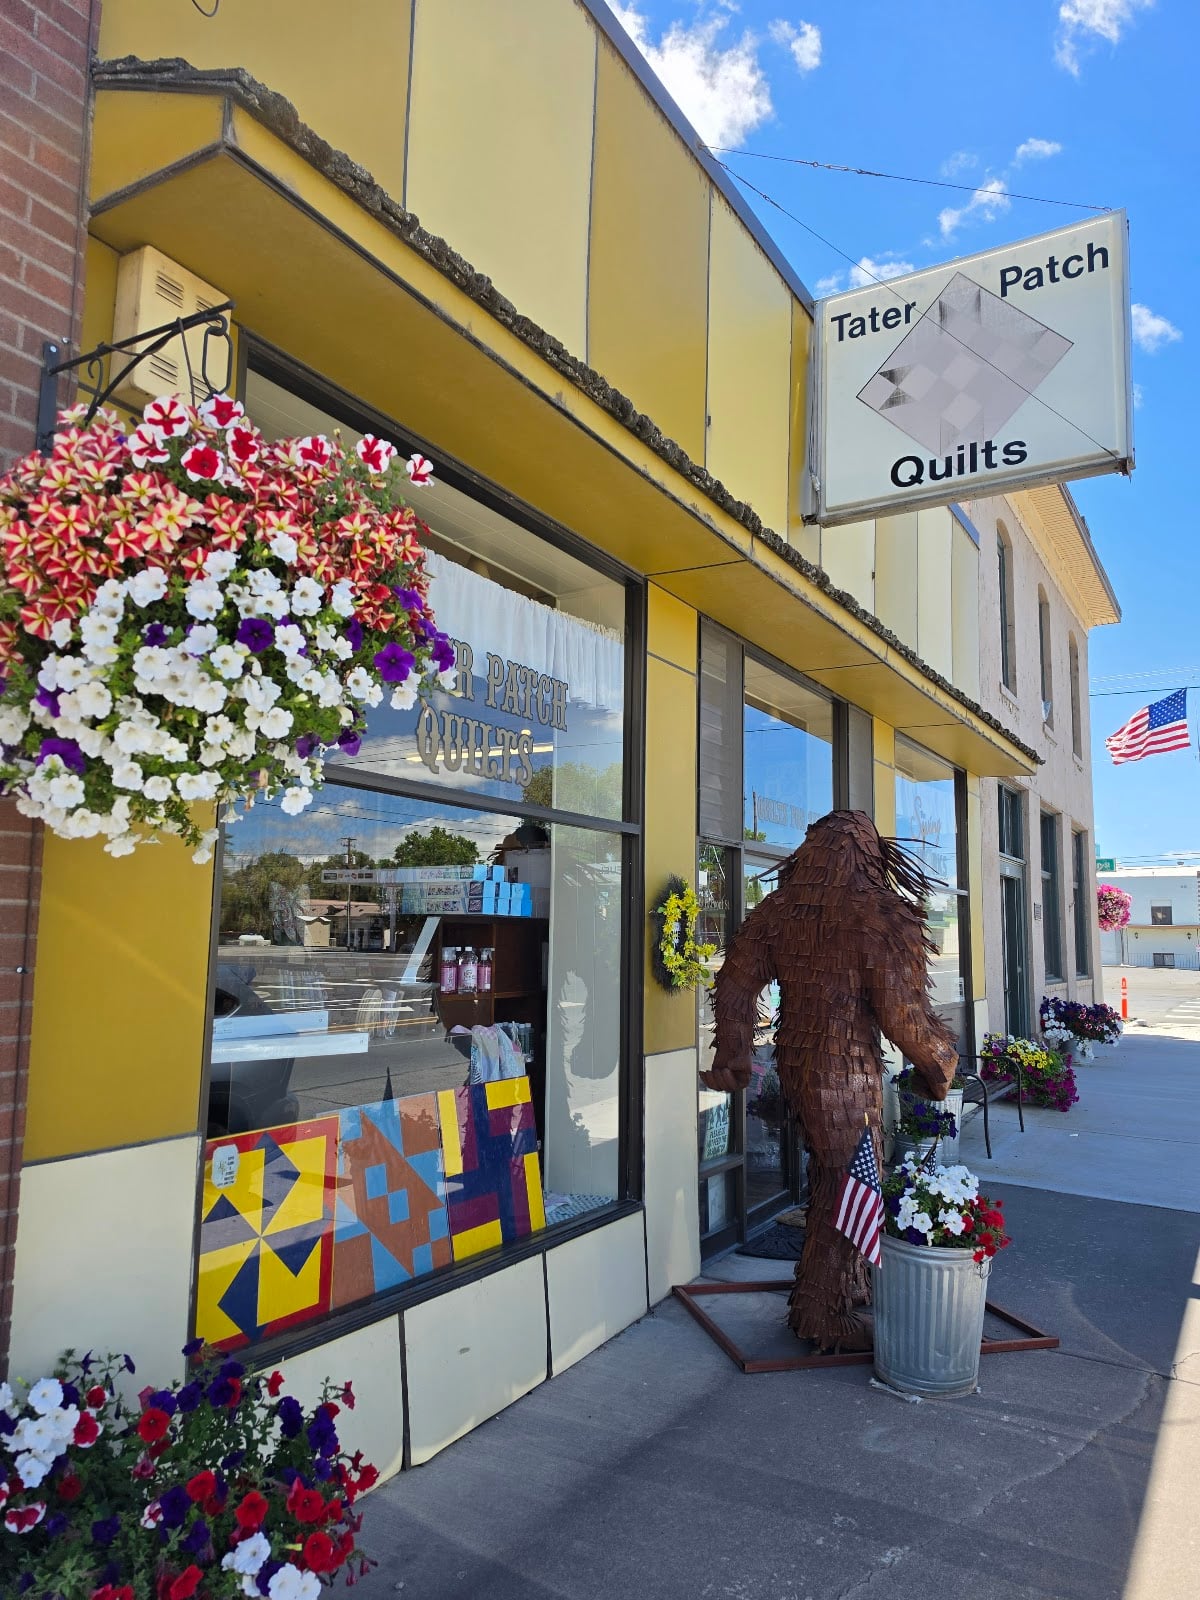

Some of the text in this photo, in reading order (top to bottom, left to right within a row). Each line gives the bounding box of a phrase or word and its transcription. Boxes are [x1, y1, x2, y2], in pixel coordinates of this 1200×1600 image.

[830, 242, 1109, 342] Tater Patch
[890, 440, 1028, 488] Quilts
[486, 652, 568, 732] PATCH
[416, 706, 534, 787] QUILTS
